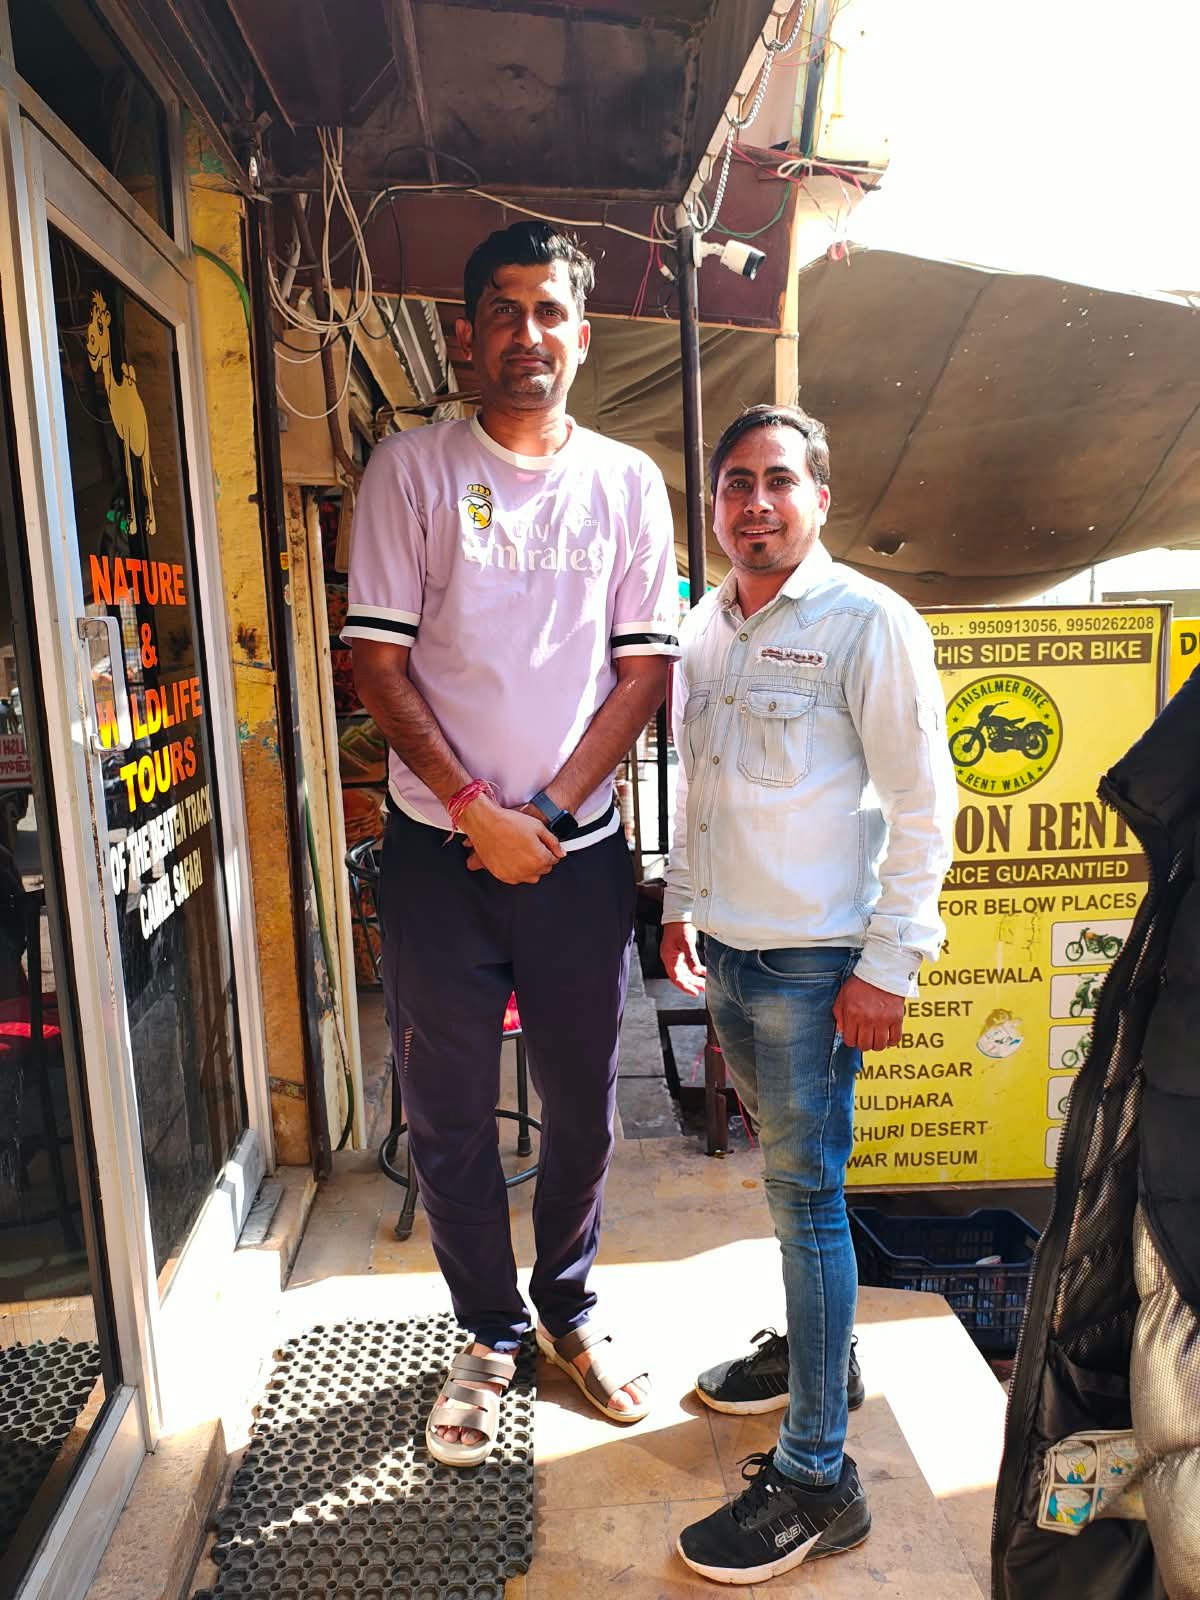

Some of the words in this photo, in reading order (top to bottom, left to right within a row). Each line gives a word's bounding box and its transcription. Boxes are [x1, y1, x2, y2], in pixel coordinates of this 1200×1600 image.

[89, 554, 187, 606] NATURE
[927, 622, 955, 636] ob.
[968, 619, 1061, 635] 9950913056,
[1066, 616, 1154, 632] 9950262208
[141, 622, 158, 669] &
[935, 645, 974, 665] HIS
[980, 643, 1032, 663] SIDE
[1037, 641, 1084, 661] FOR
[1090, 639, 1142, 660] BIKE
[956, 680, 1020, 712] JAISALMER
[1022, 685, 1049, 709] BIKE
[96, 676, 203, 750] WLDLIFE
[120, 735, 197, 813] TOURS
[966, 773, 997, 791] RENT
[1002, 771, 1036, 791] WALA
[109, 841, 127, 896] OF
[126, 824, 152, 881] THE
[185, 783, 213, 836] TRACK
[954, 805, 1013, 854] ON
[1027, 801, 1129, 851] RENT
[944, 866, 990, 885] RICE
[996, 861, 1129, 884] GUARANTIED
[139, 872, 175, 940] CAMEL
[172, 847, 204, 907] SAFARI
[938, 900, 978, 917] FOR
[984, 896, 1057, 916] BELOW
[1061, 892, 1137, 912] PLACES
[917, 967, 1043, 987] LONGEWALA
[904, 1000, 973, 1018] ESERT
[896, 1032, 945, 1049] BAG
[855, 1061, 973, 1080] MARSAGAR
[910, 1120, 989, 1138] DESERT
[846, 1152, 888, 1169] WAR
[893, 1150, 979, 1168] MUSEUM
